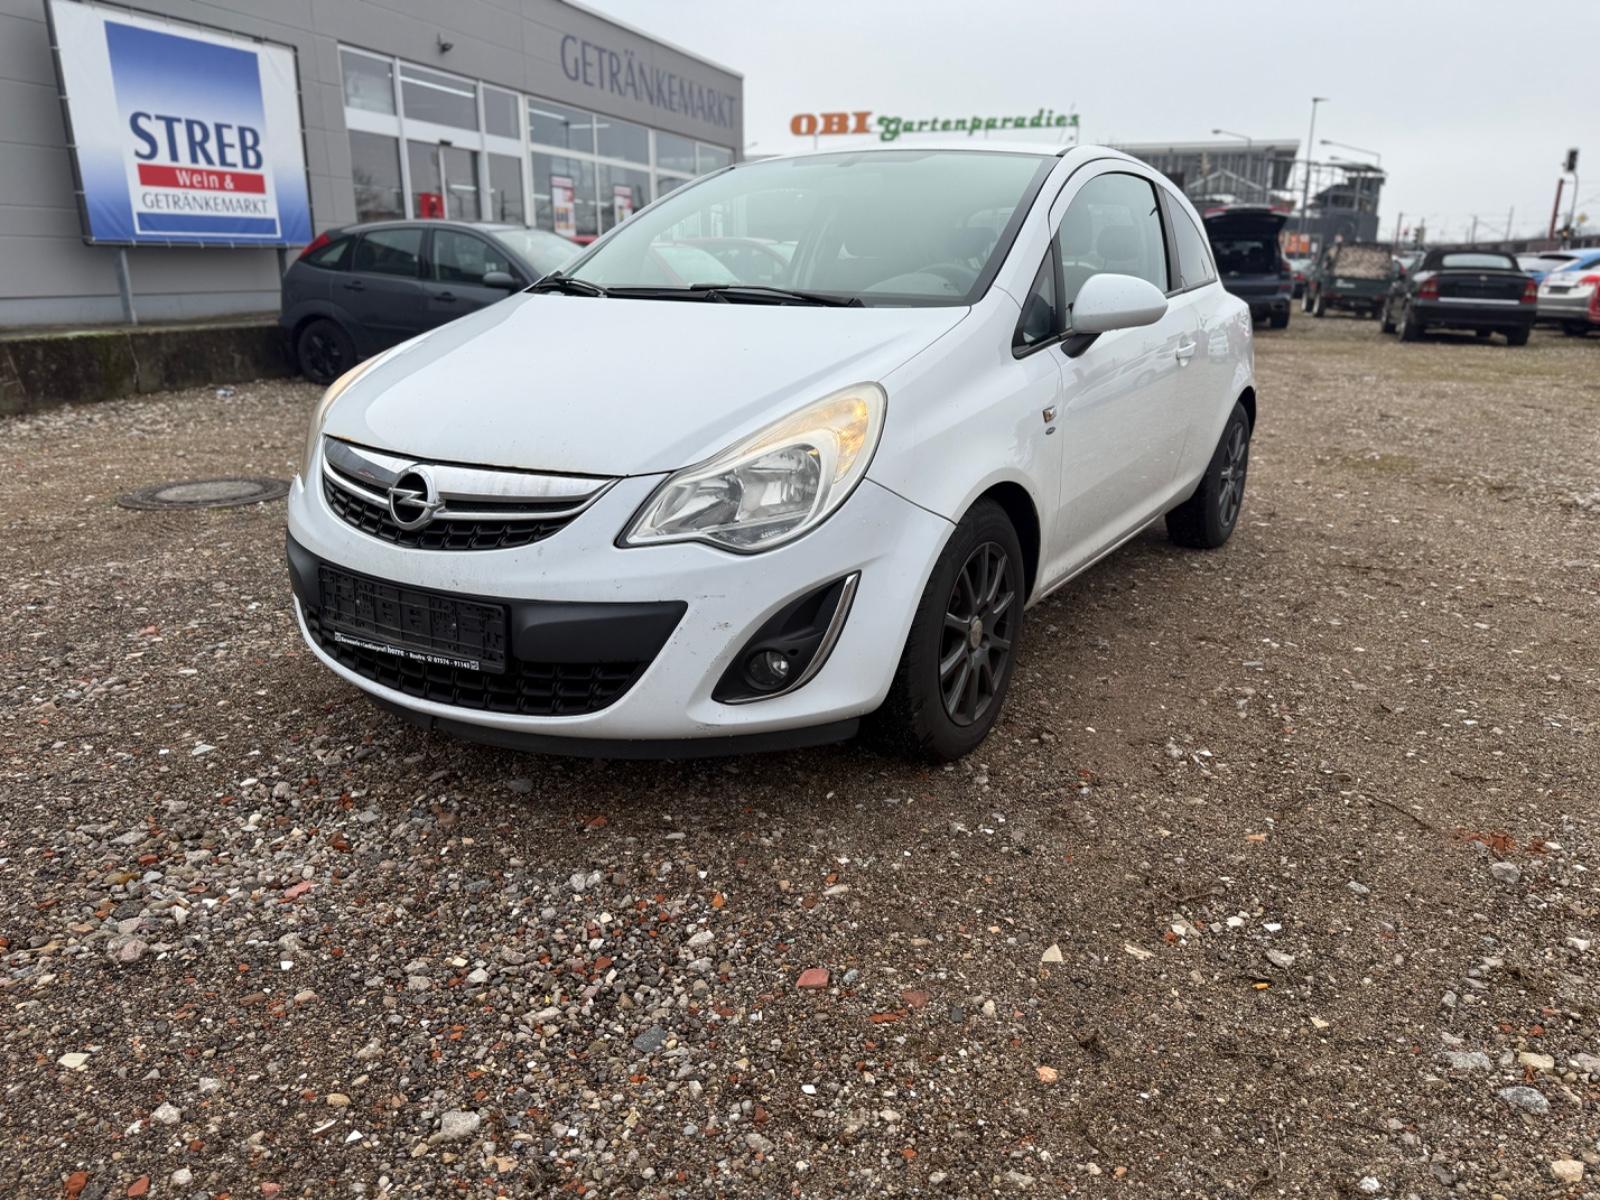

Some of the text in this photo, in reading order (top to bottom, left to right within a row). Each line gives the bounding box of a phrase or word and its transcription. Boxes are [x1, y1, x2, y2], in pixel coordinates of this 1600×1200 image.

[560, 34, 737, 129] GETRÄNKEMARKT
[790, 111, 872, 136] OBI
[129, 111, 264, 170] STREB
[175, 169, 235, 191] Wein &
[141, 191, 269, 215] GETRÄNKEMARKT
